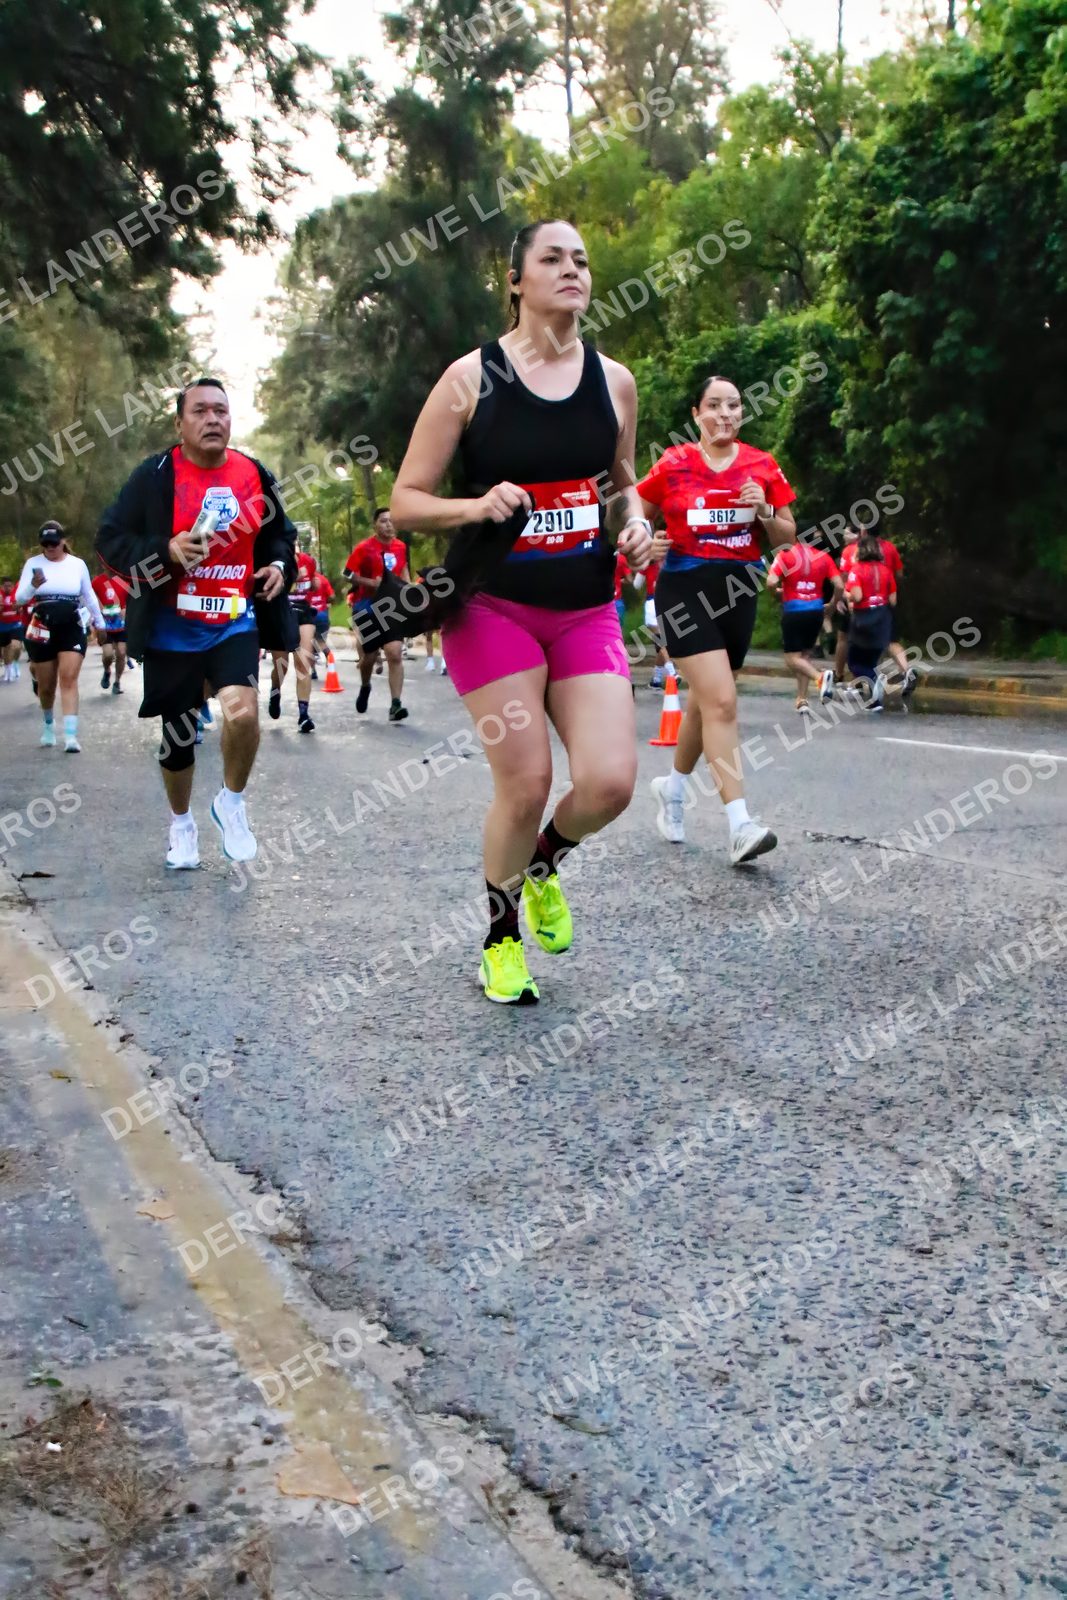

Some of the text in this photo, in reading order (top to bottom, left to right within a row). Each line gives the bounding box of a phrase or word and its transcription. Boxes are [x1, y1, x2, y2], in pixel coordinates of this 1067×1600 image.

[533, 509, 574, 534] 2910
[709, 509, 736, 523] 3612
[200, 597, 225, 612] 1917
